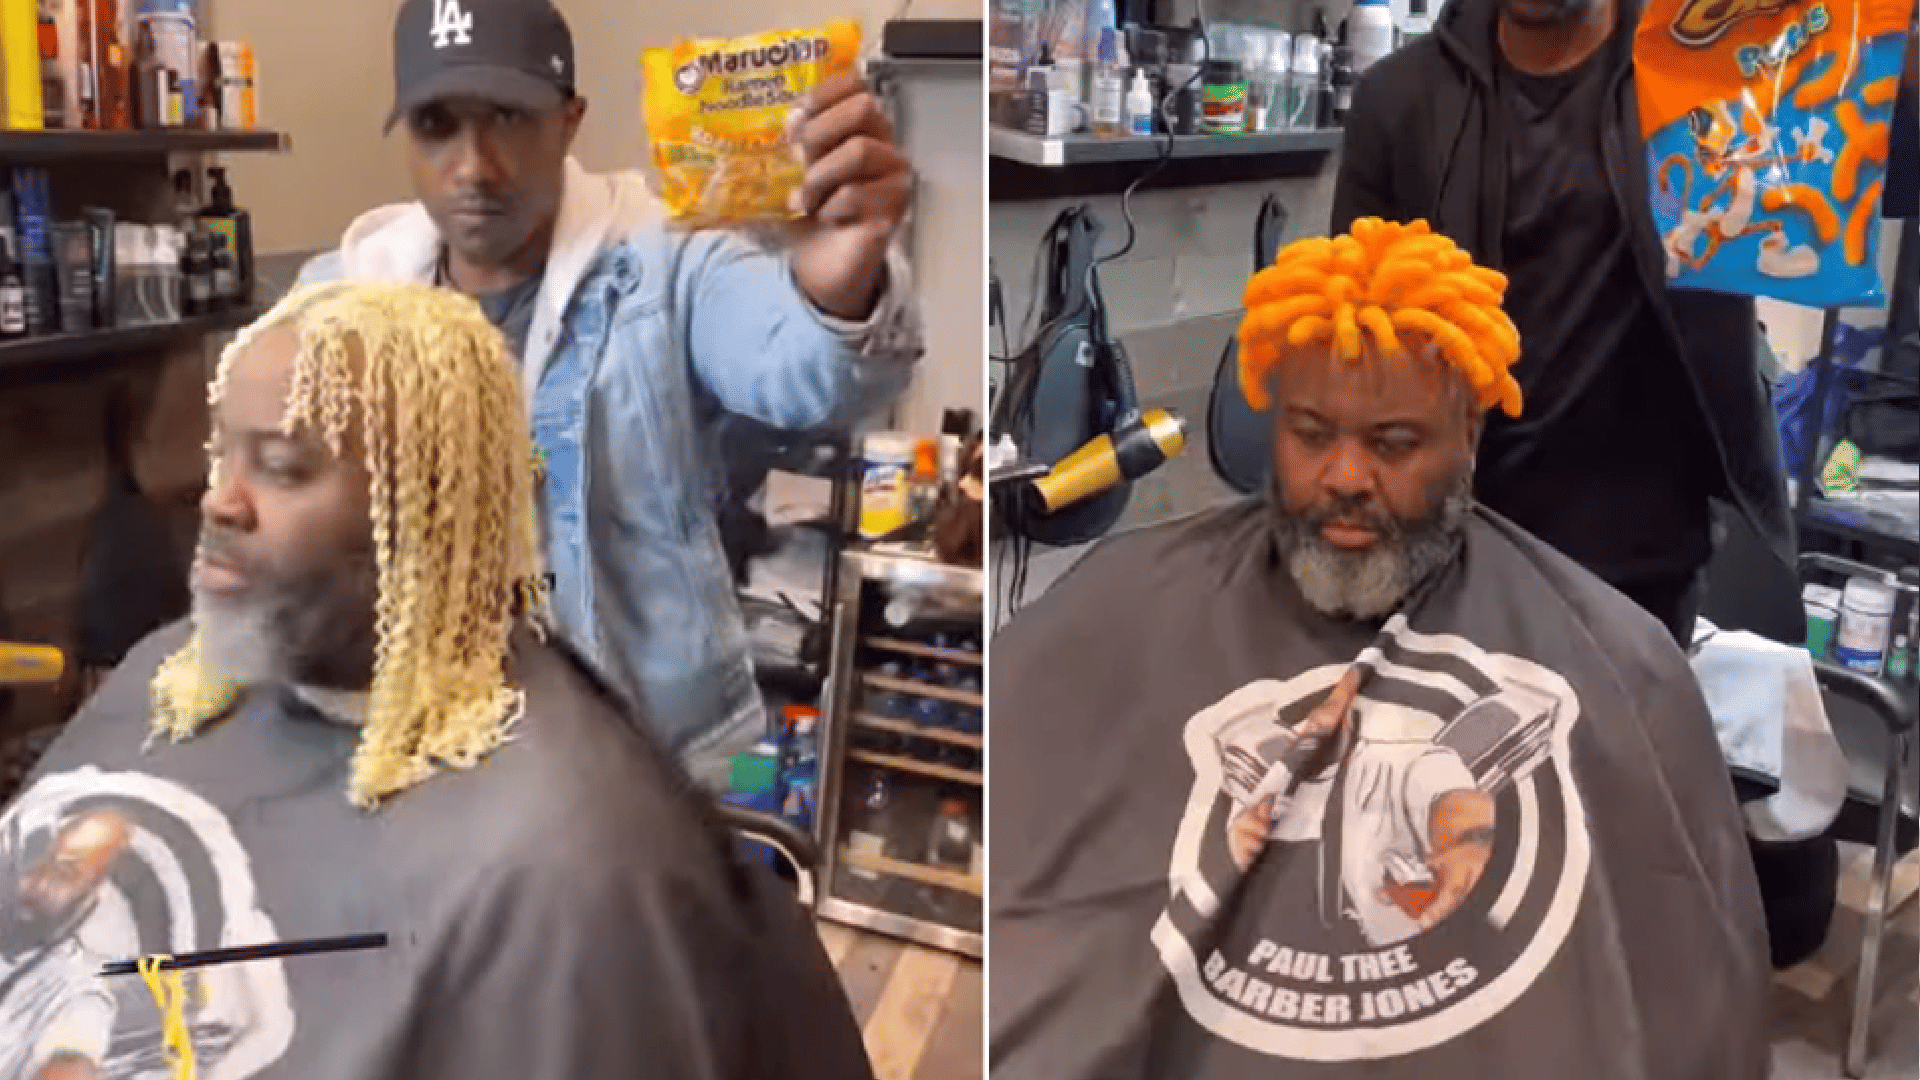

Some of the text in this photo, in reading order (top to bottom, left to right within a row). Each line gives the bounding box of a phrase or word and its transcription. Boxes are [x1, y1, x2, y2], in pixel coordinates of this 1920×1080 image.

[429, 0, 474, 48] LA
[1248, 938, 1418, 983] PAUL THEE
[1203, 947, 1479, 1024] BARBER JONES
